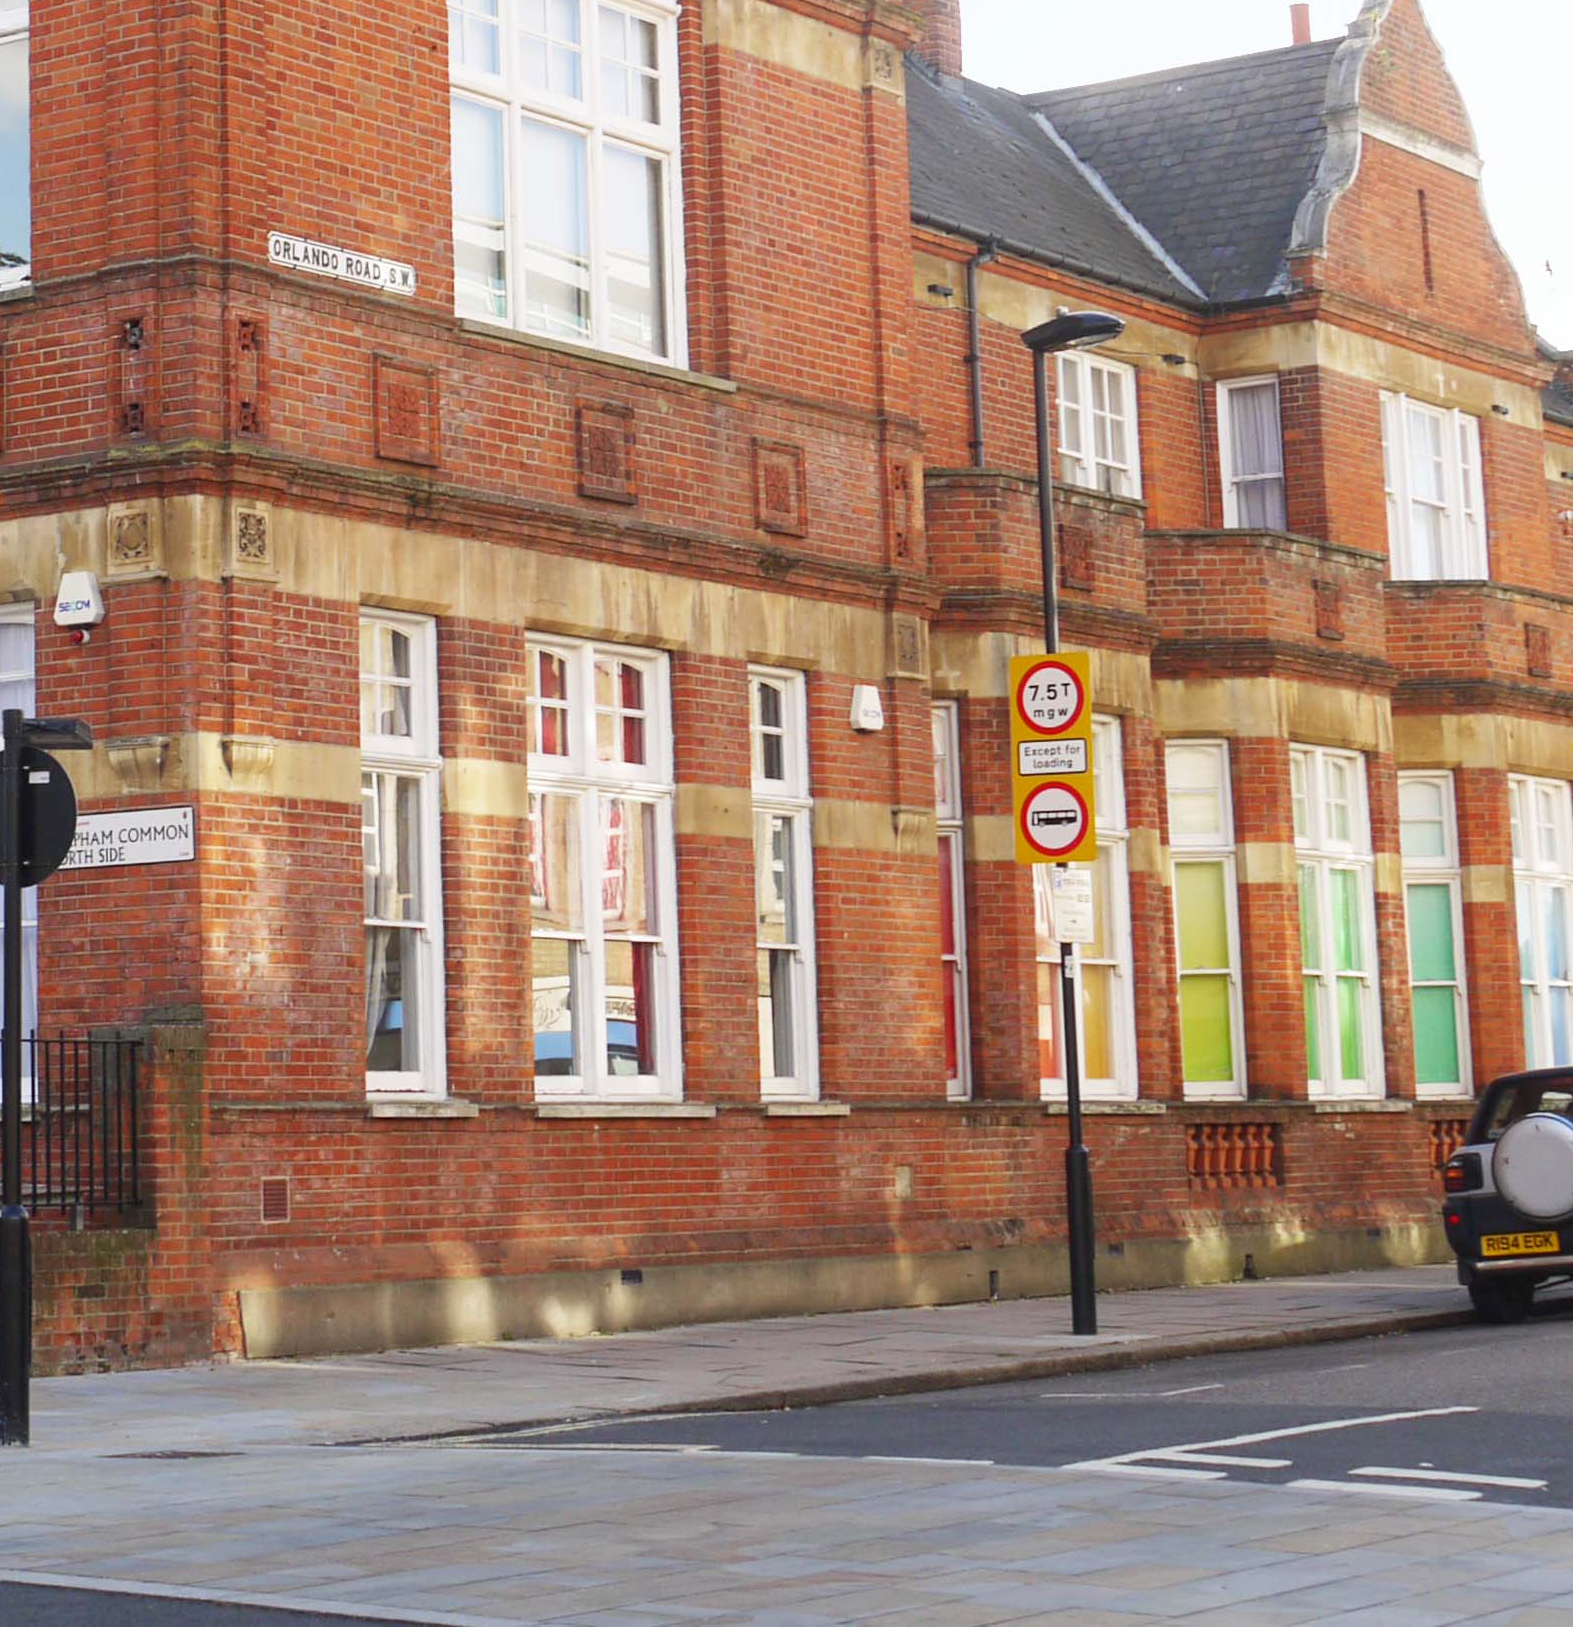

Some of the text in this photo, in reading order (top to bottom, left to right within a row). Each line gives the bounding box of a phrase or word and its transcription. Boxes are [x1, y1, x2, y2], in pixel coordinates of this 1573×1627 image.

[273, 238, 339, 270] ORLANDO
[1023, 744, 1081, 757] Except for
[1032, 758, 1074, 770] loading
[72, 823, 189, 847] PHAM COMMON
[98, 846, 126, 863] SIDE
[1523, 1234, 1554, 1249] EGK
